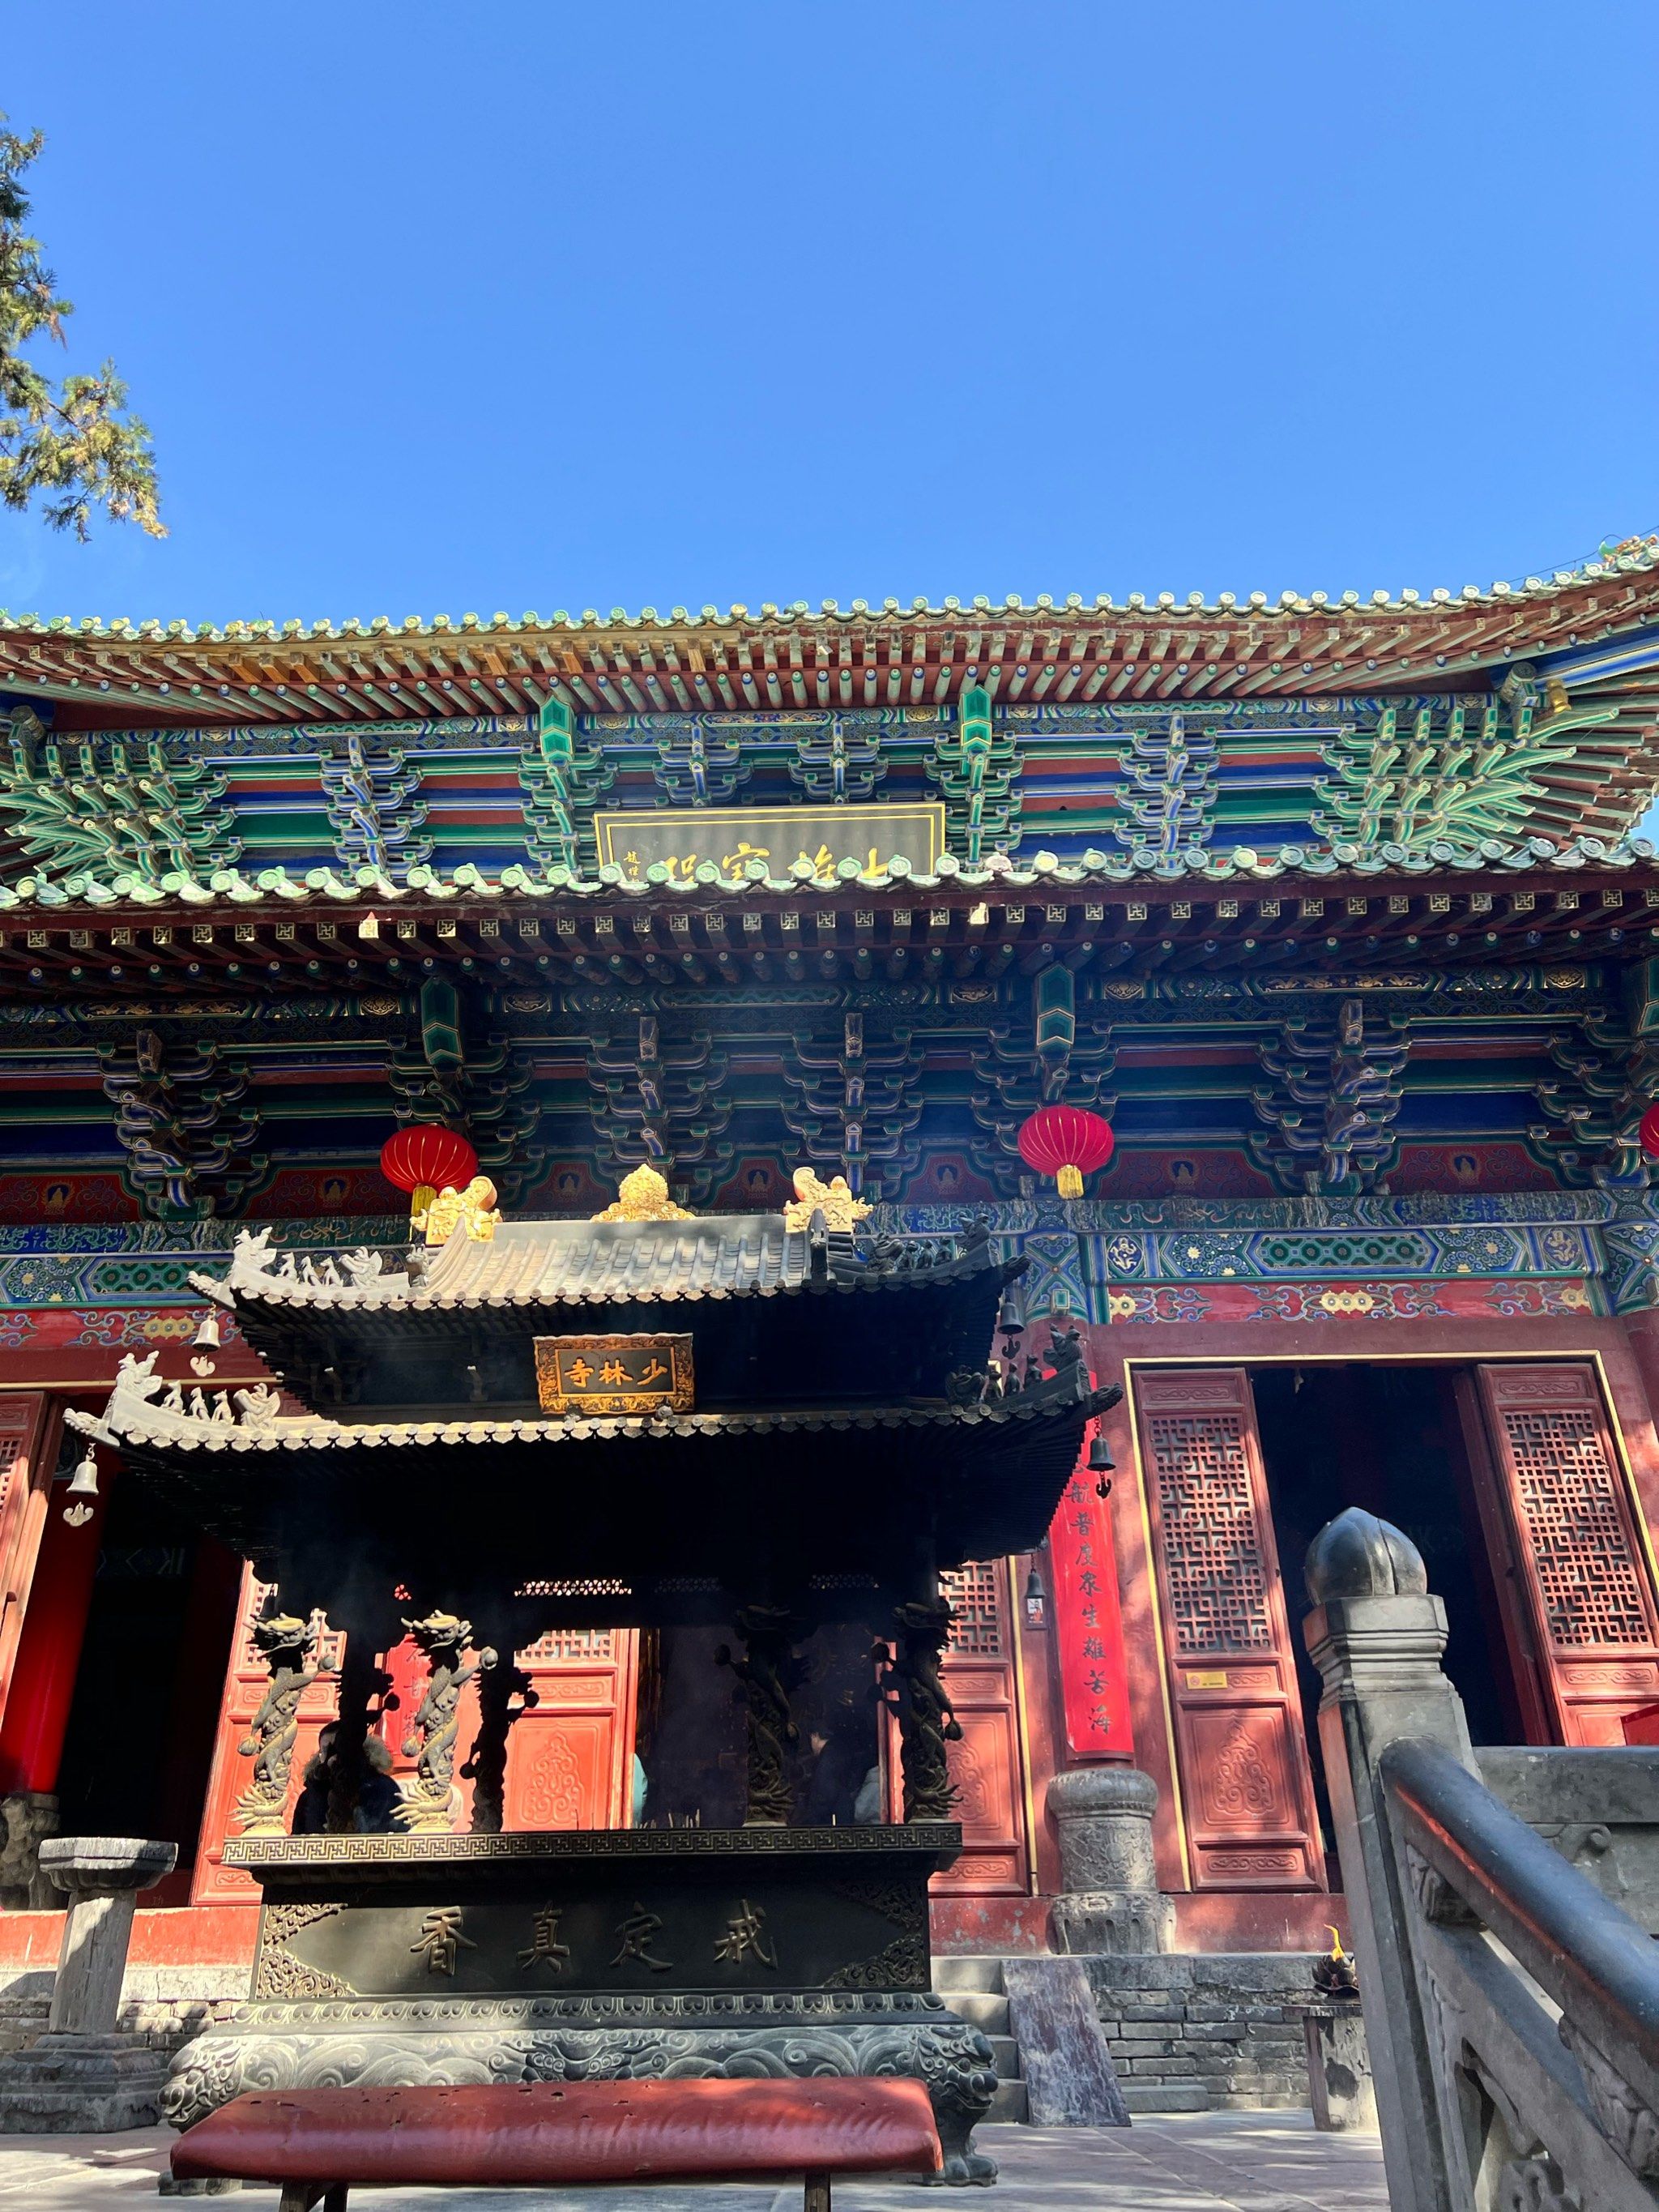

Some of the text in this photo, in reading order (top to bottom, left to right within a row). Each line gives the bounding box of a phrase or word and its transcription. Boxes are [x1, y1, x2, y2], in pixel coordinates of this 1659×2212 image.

[565, 1358, 667, 1387] 少林寺
[410, 1899, 778, 1977] 戒定真香
